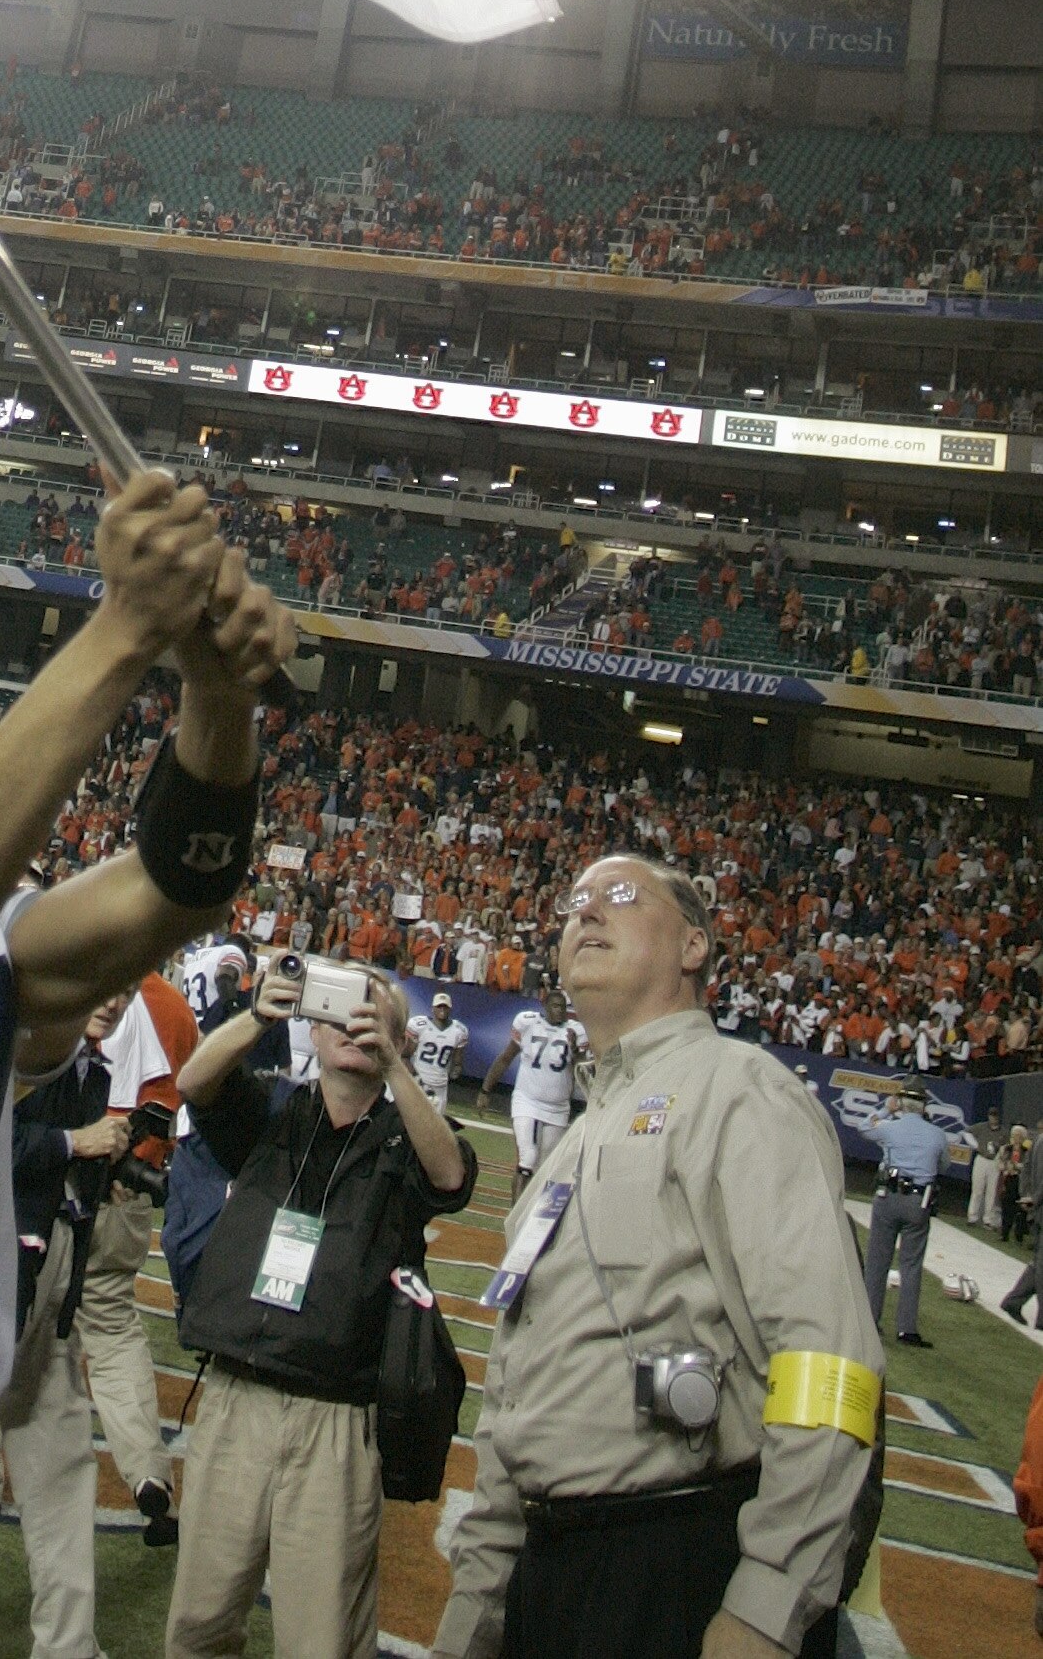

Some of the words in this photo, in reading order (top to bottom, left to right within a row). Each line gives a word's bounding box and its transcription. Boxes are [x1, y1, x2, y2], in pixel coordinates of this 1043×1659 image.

[648, 19, 797, 55] Naturly
[808, 23, 895, 54] Fresh
[90, 357, 117, 366] POWER
[153, 365, 179, 374] POWER
[211, 372, 238, 381] POWER
[726, 432, 773, 445] DOME
[791, 428, 927, 452] www.gadome.com
[942, 451, 991, 463] DOME
[504, 641, 683, 685] MISSISSIPPI
[686, 666, 783, 696] STATE
[419, 1041, 454, 1069] 20
[530, 1035, 569, 1073] 73
[261, 1277, 296, 1302] AM
[496, 1272, 517, 1300] P
